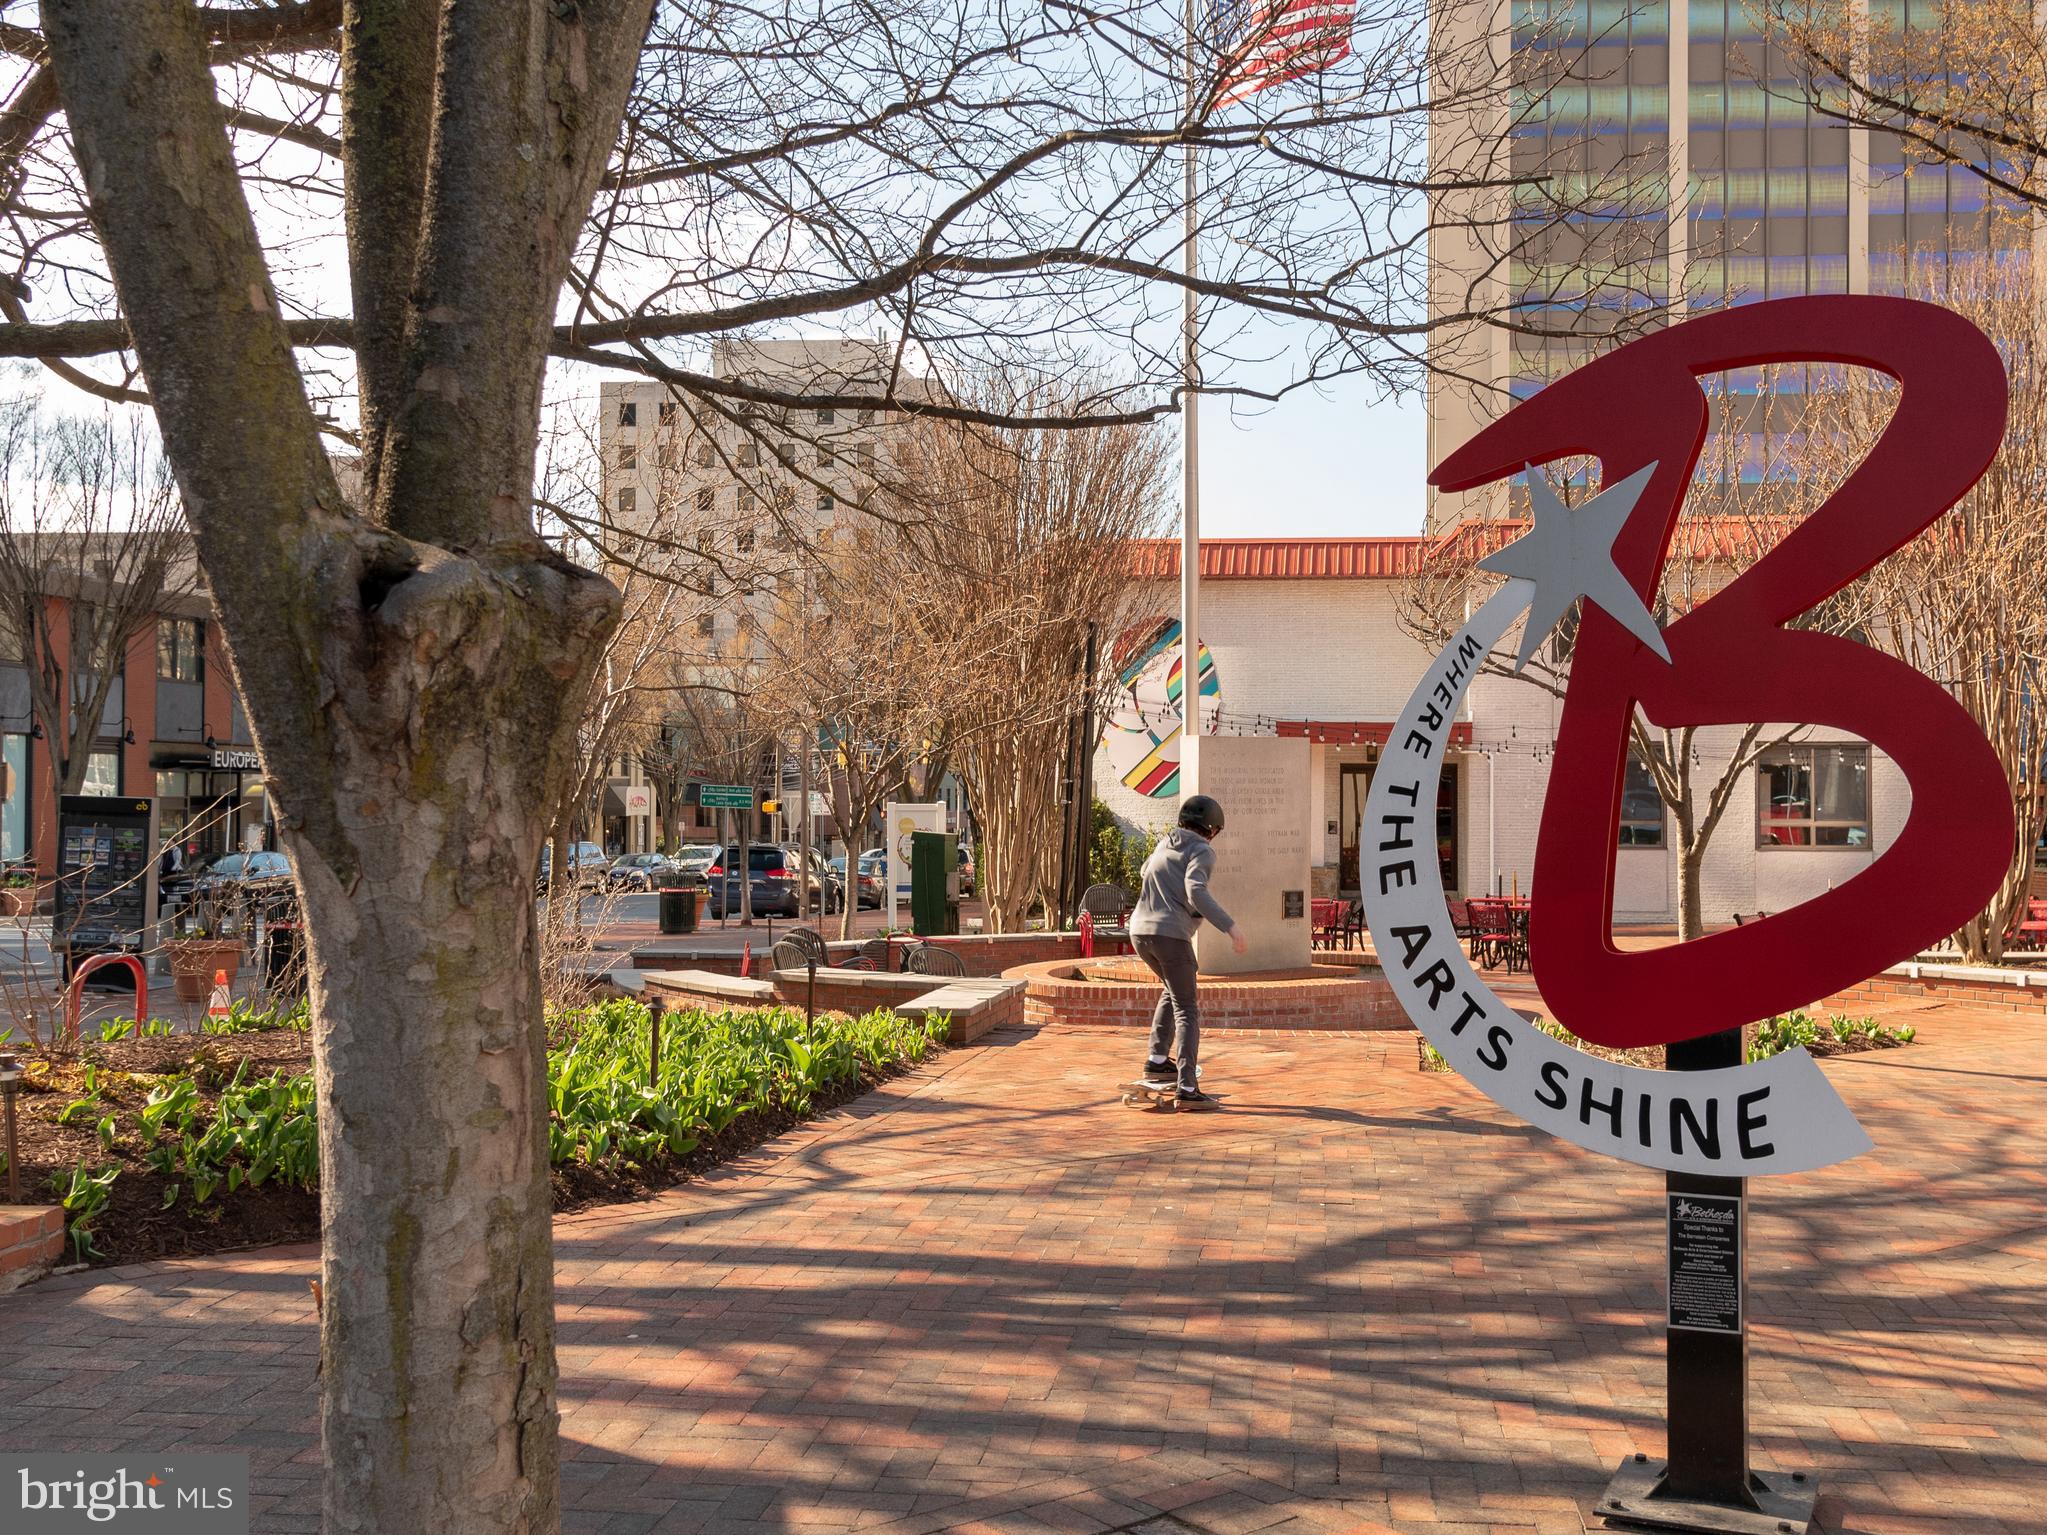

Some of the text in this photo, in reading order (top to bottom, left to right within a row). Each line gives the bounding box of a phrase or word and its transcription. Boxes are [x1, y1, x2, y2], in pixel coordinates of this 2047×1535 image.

[1404, 634, 1482, 760] WHERE
[1379, 780, 1420, 895] THE
[1391, 924, 1514, 1073] ARTS
[1535, 1061, 1775, 1160] SHINE
[1690, 1206, 1734, 1220] Bethesda
